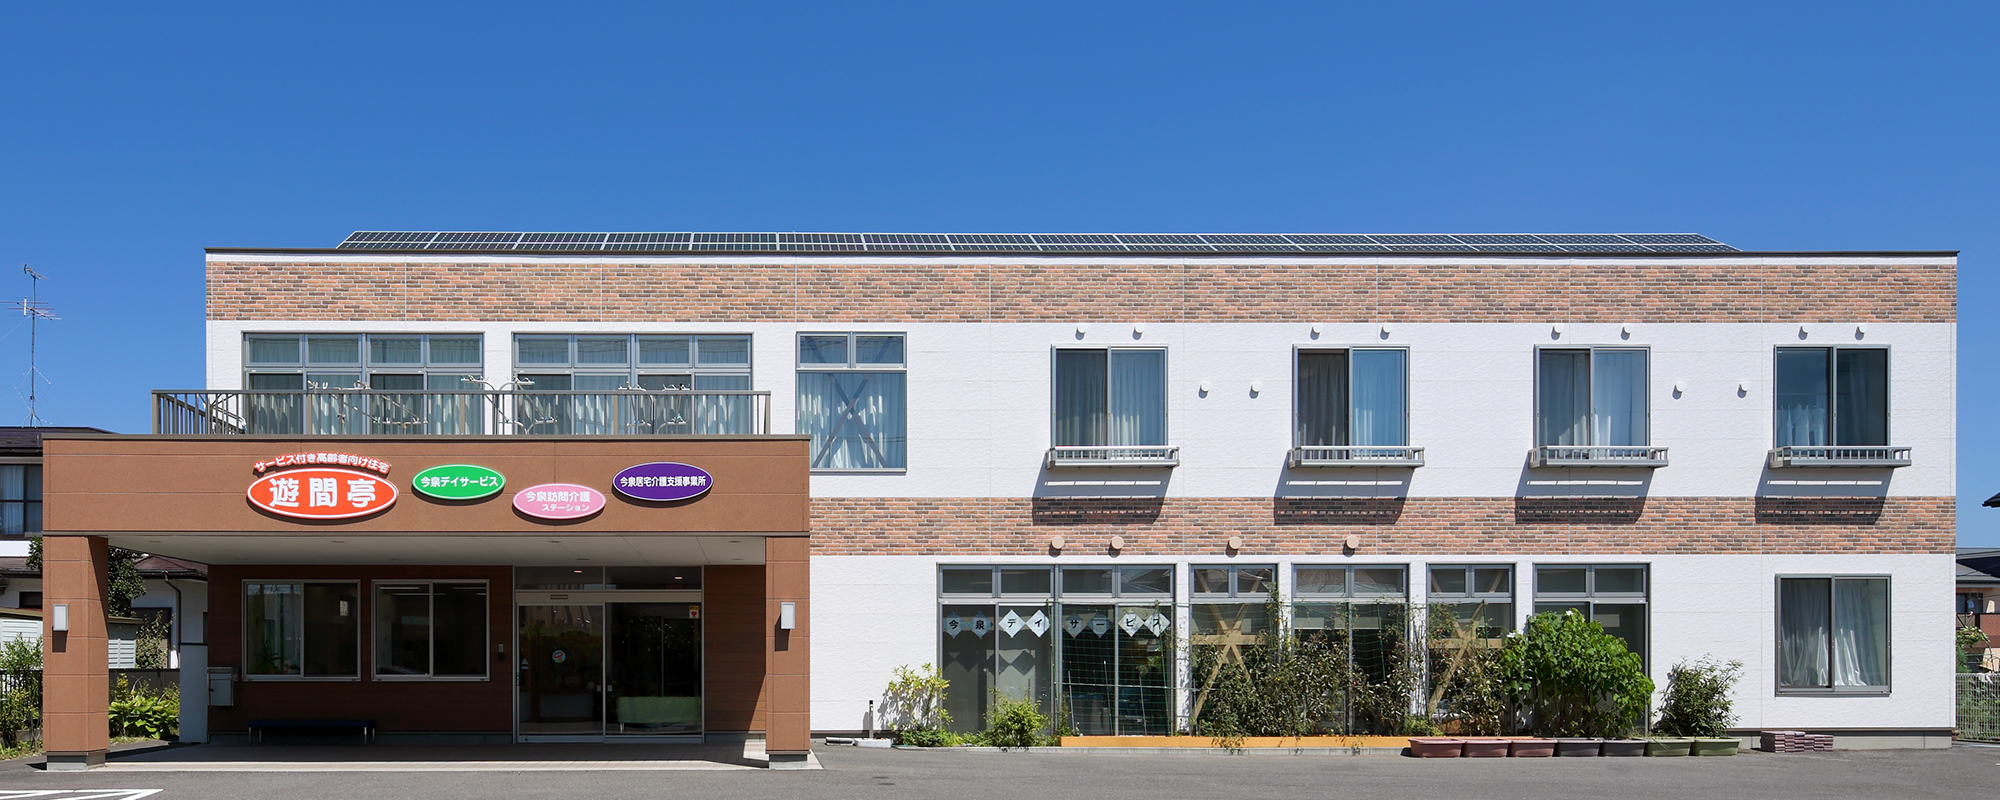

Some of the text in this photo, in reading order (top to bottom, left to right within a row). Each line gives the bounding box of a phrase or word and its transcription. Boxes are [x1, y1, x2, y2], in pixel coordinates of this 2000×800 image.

[254, 452, 390, 472] サービス付き高齢者向け住宅
[420, 476, 499, 487] 今泉デイサービス
[620, 475, 706, 487] 今泉居宅介護支援事業所
[269, 477, 376, 507] 遊間亭
[525, 491, 590, 503] 今泉訪問介護
[541, 503, 590, 512] ステーション
